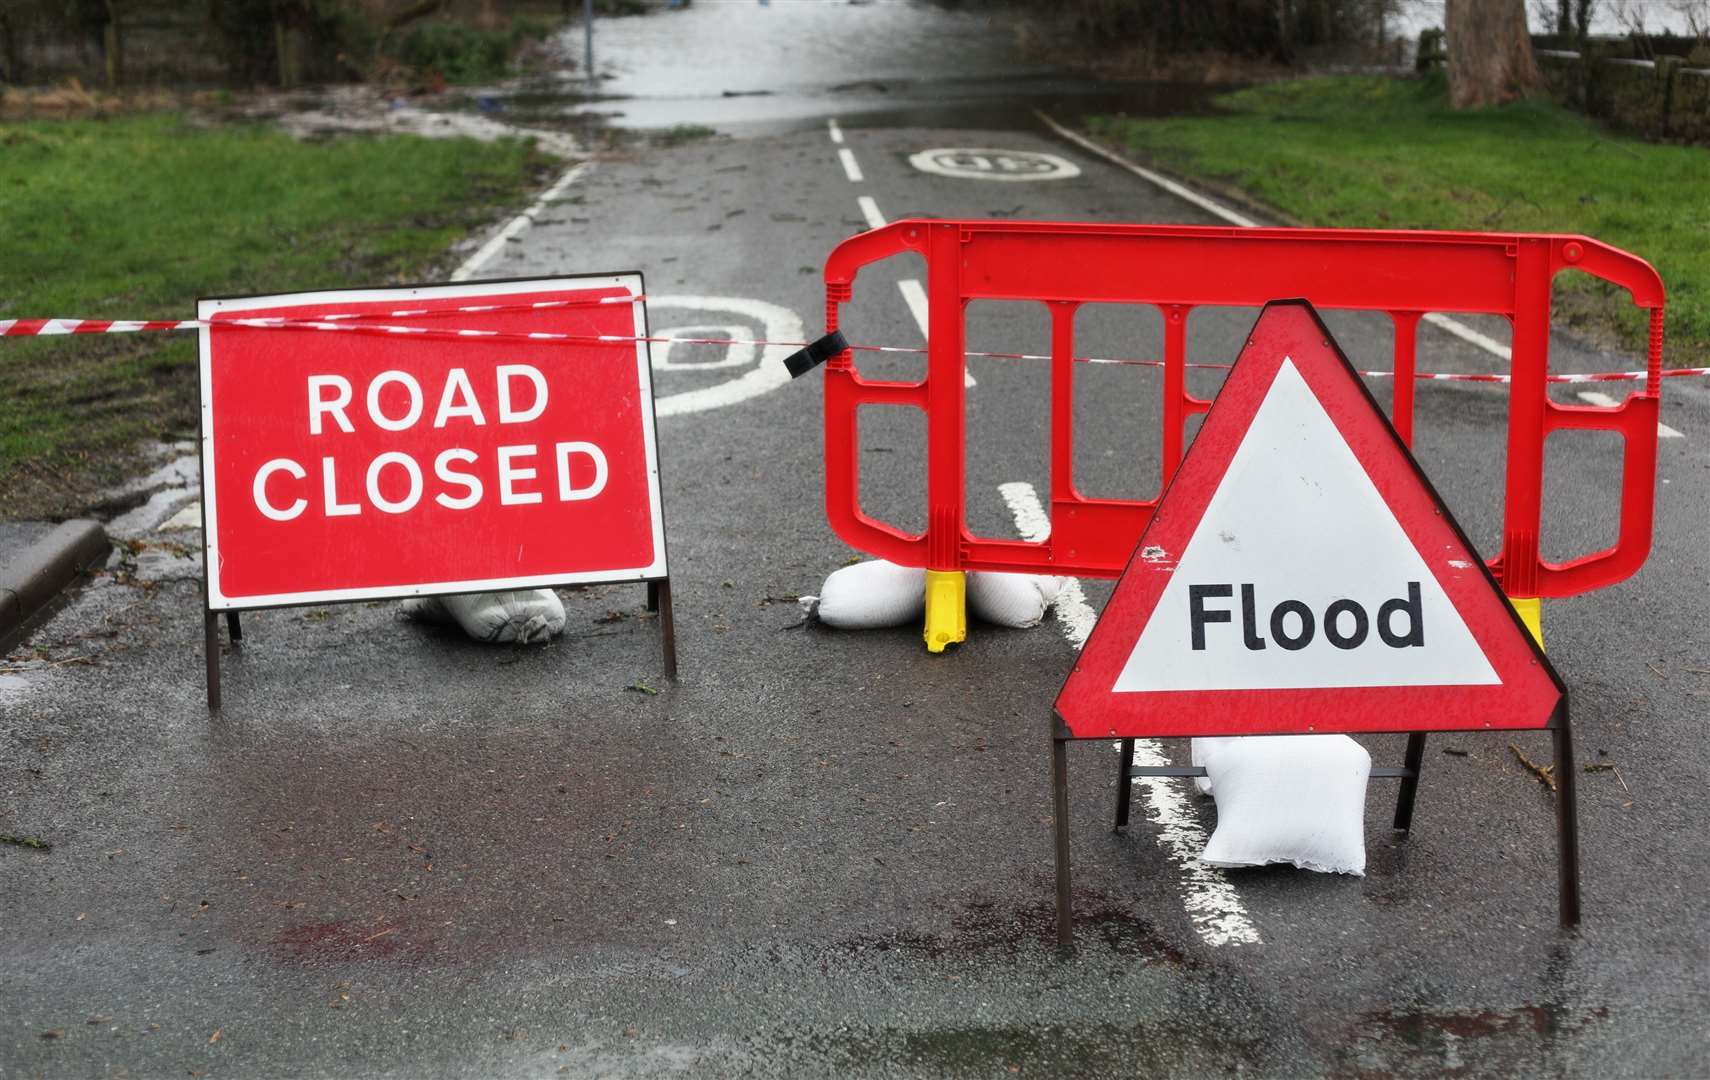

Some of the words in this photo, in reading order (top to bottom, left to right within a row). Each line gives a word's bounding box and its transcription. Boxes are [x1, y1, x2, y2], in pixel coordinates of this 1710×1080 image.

[307, 364, 549, 435] ROAD
[252, 441, 609, 521] CLOSED
[1188, 581, 1425, 651] Flood
